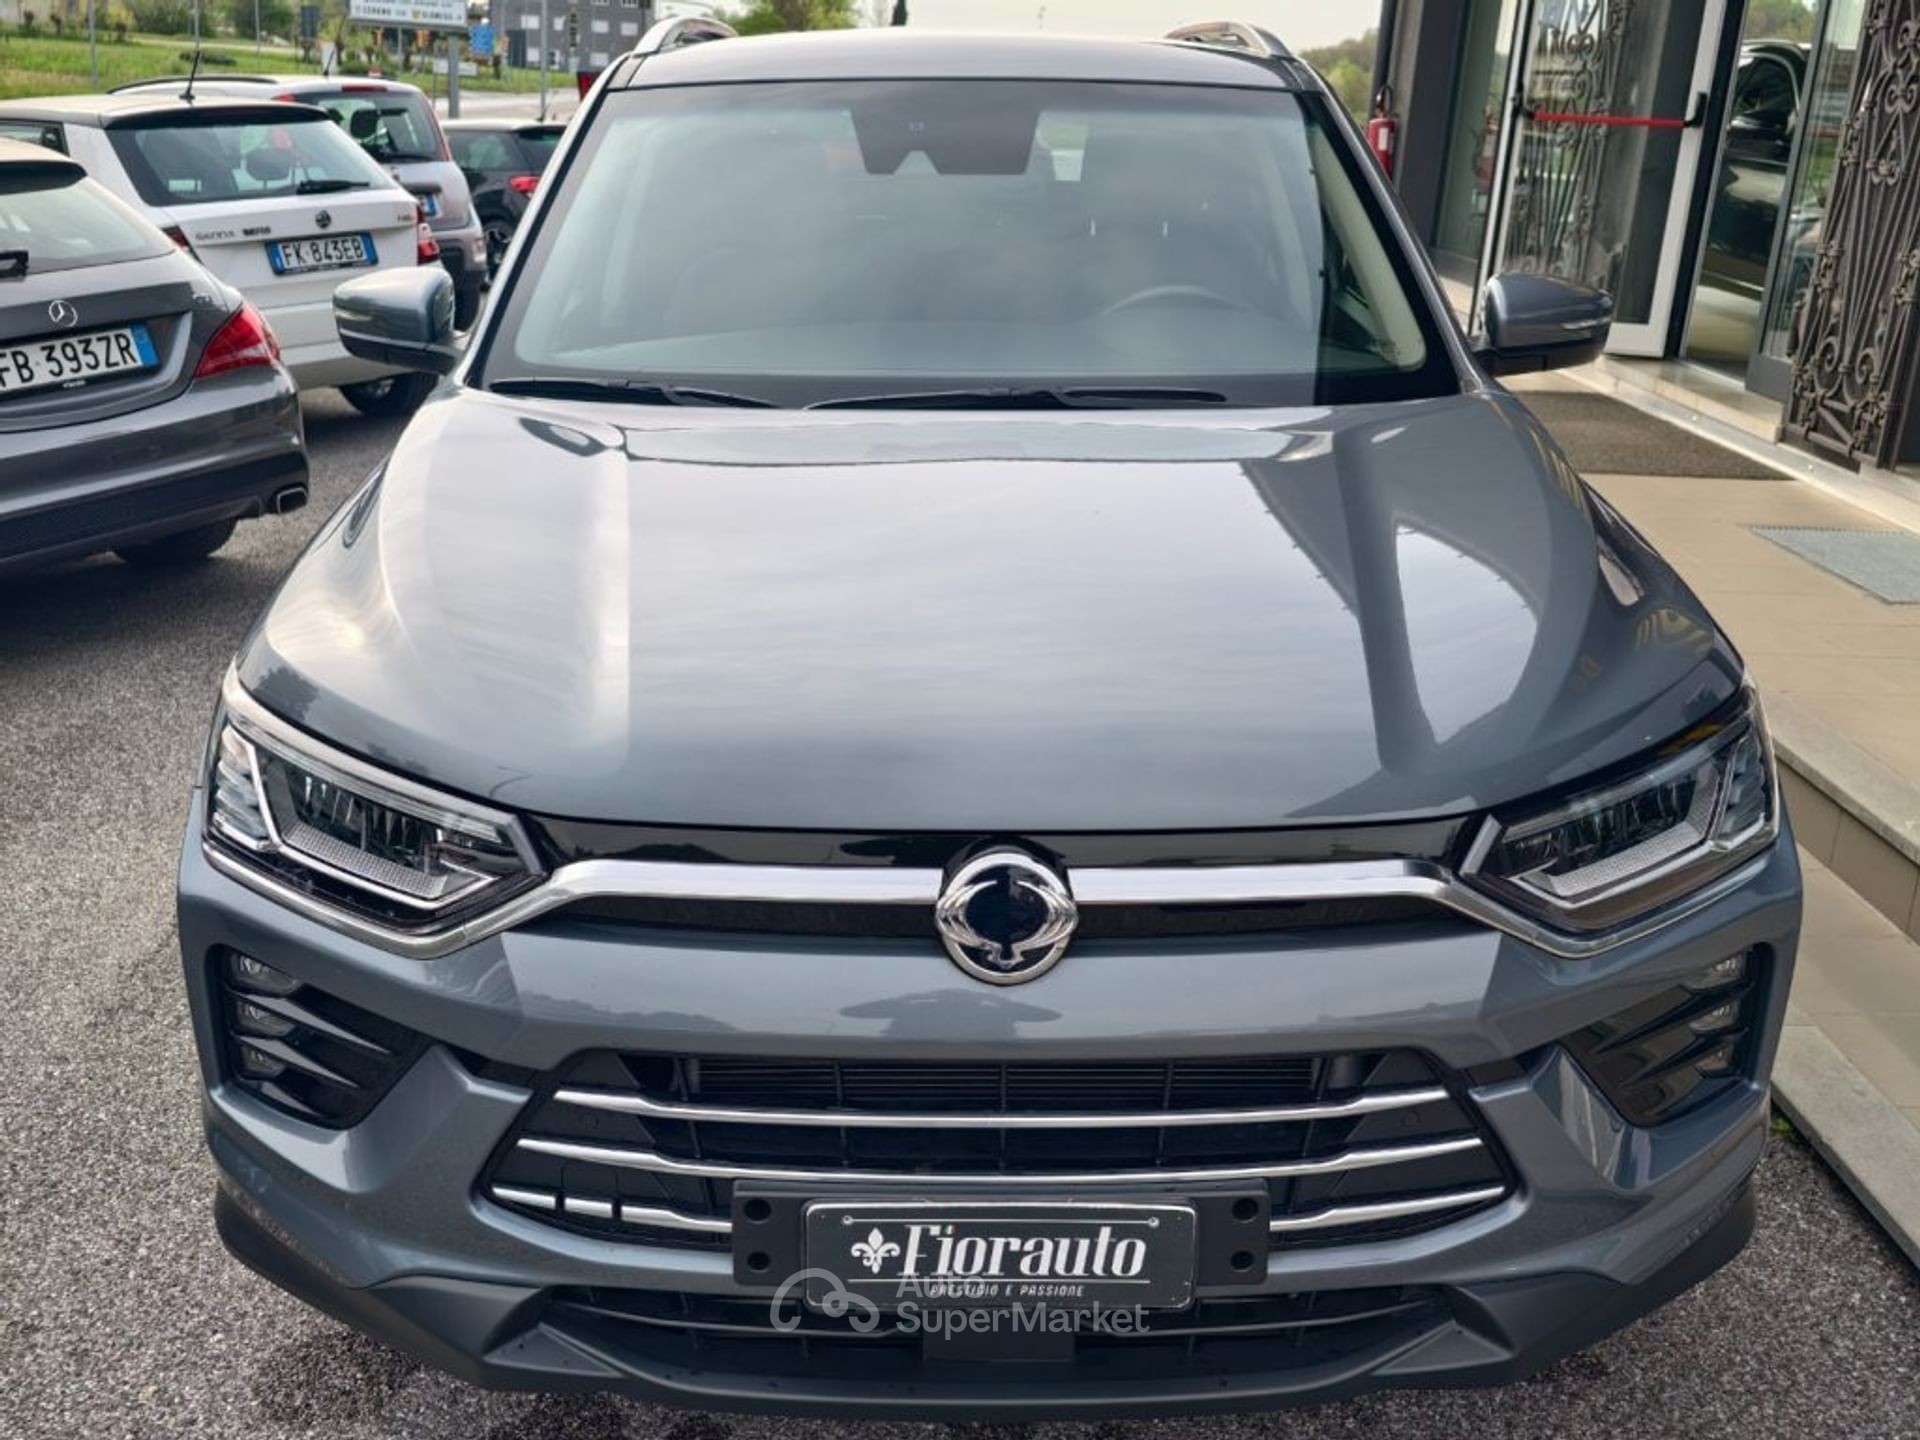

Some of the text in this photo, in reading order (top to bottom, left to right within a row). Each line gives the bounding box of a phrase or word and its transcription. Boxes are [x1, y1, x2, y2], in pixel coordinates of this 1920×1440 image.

[282, 241, 306, 267] FK
[310, 238, 363, 262] 843EB
[0, 333, 137, 388] FB 393ZR
[898, 1224, 1147, 1277] Fiorauto
[1005, 1284, 1014, 1297] E
[1020, 1284, 1085, 1298] PASSIONE
